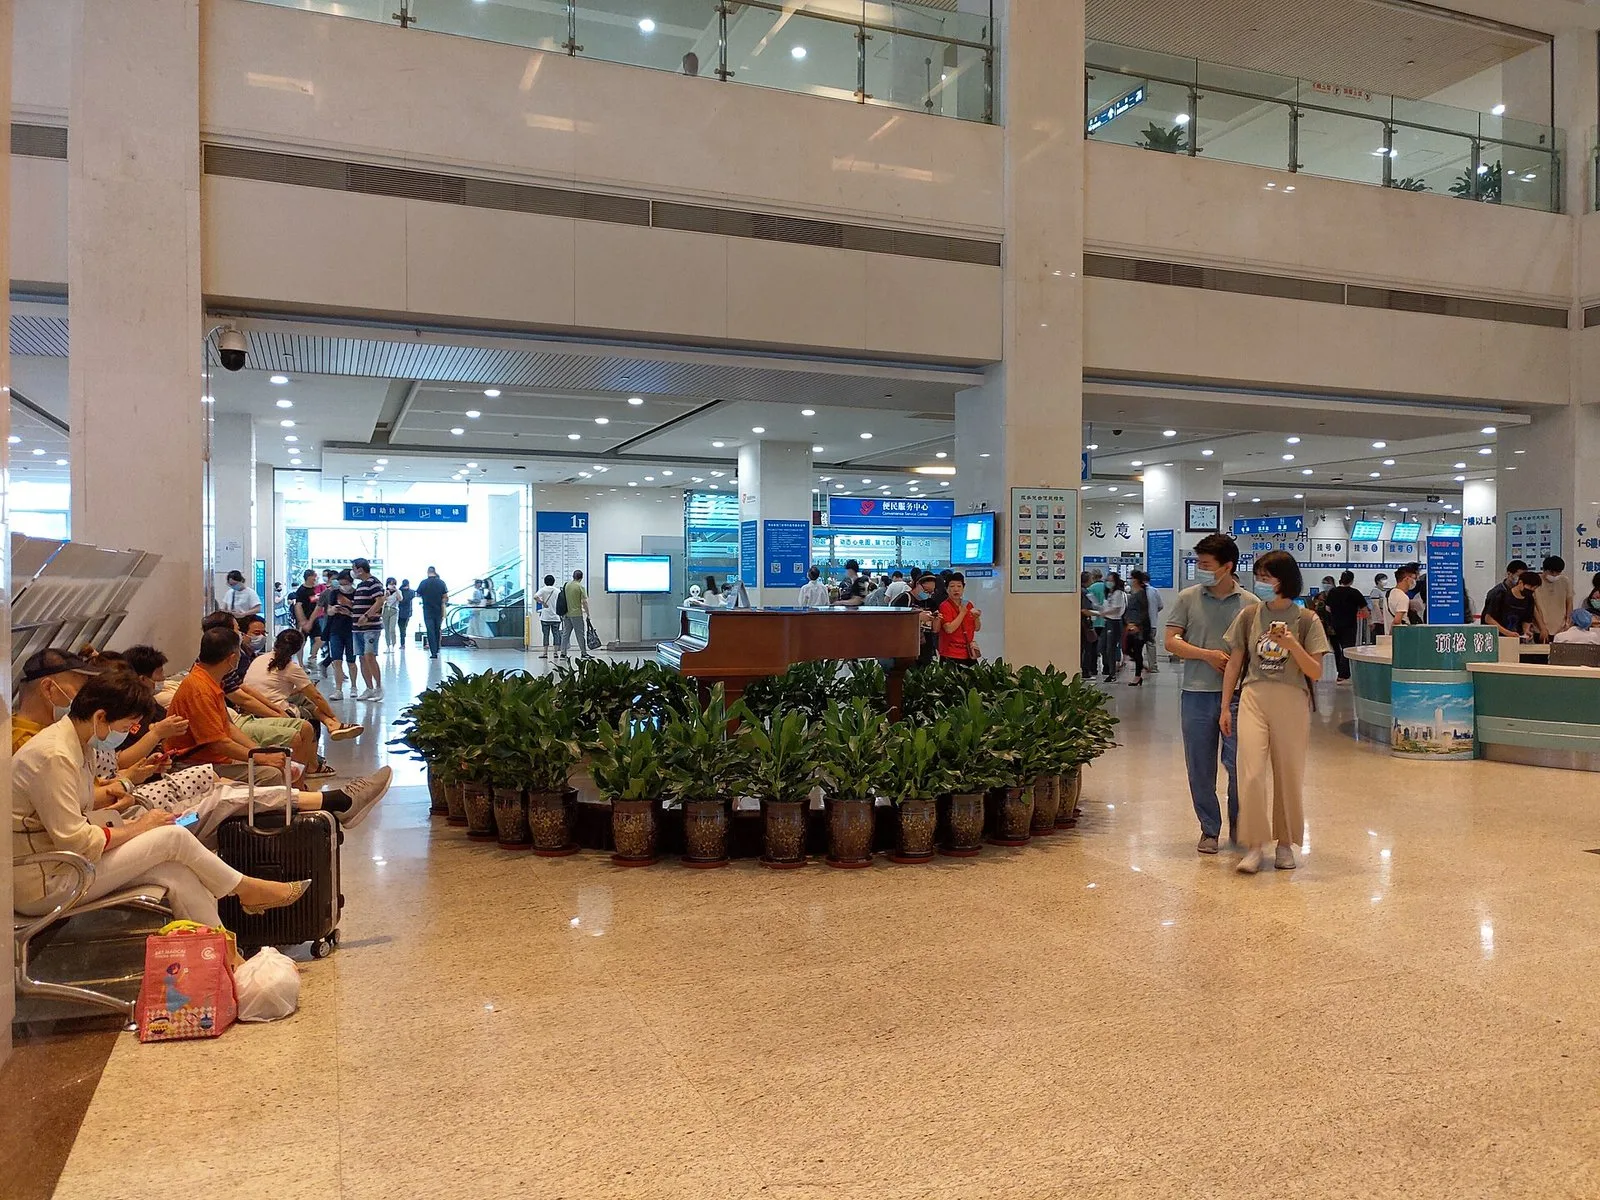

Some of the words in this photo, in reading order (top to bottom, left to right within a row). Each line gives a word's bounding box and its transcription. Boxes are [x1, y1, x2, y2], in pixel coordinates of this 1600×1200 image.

[370, 506, 406, 515] 自动扶梯
[435, 507, 460, 516] 楼梯
[882, 501, 928, 511] 便民服务中心
[570, 514, 586, 528] 1F
[1088, 521, 1144, 540] 范意
[1577, 537, 1600, 549] 1-6楼
[1435, 633, 1467, 653] 预检
[1473, 632, 1494, 653] 咨询
